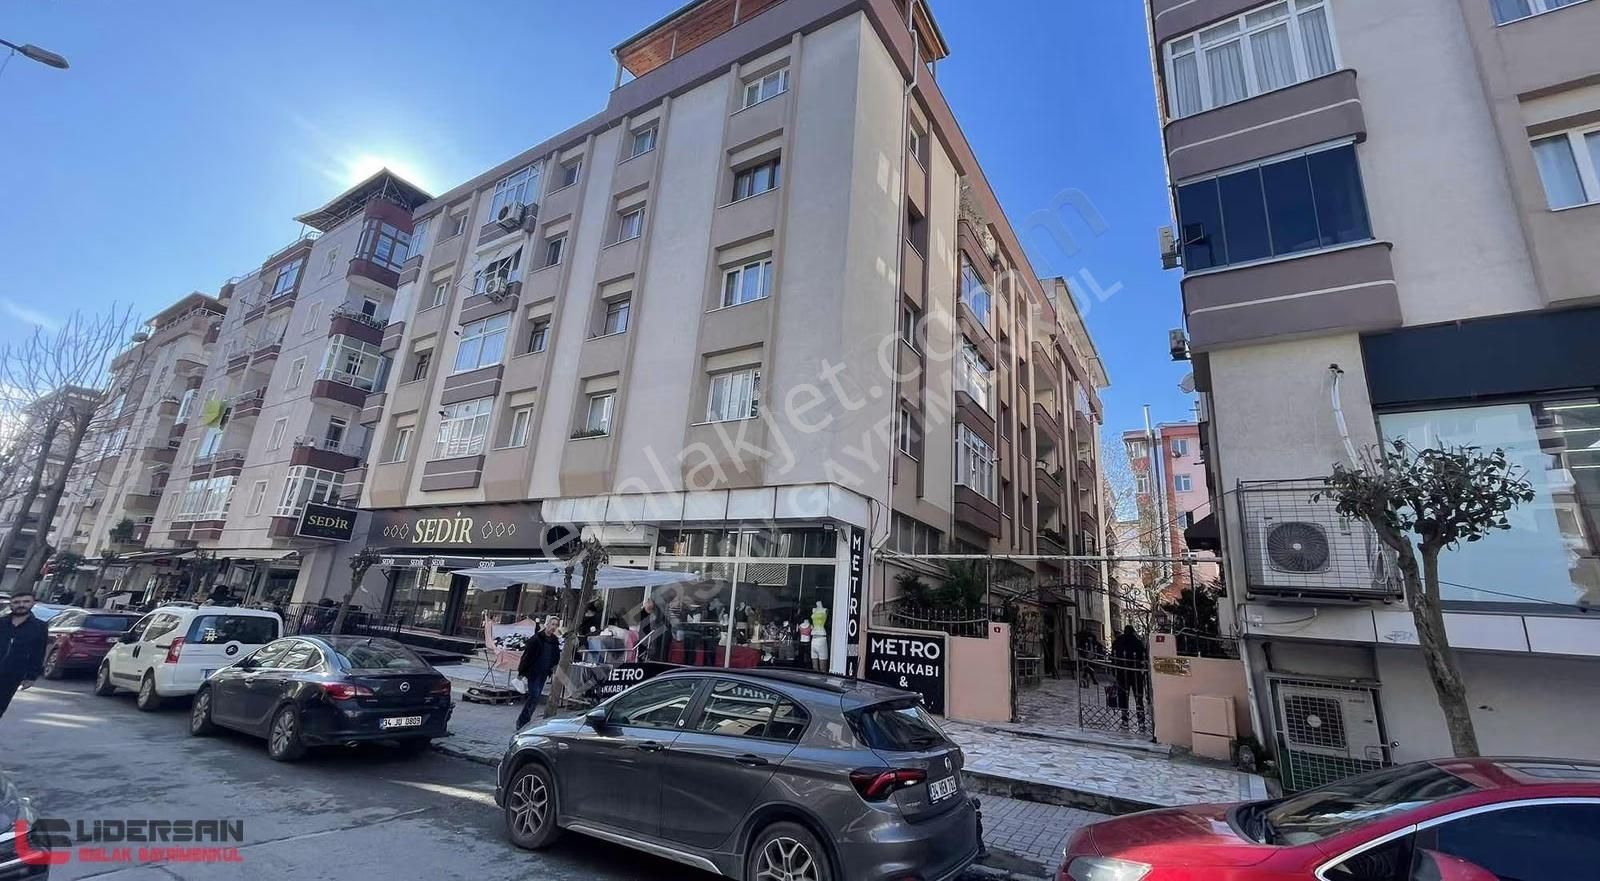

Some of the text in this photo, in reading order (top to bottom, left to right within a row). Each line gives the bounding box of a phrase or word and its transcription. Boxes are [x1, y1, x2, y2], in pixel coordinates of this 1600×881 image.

[308, 515, 348, 530] SEDİR
[412, 511, 473, 543] SEDİR
[848, 535, 861, 638] METRO
[871, 637, 940, 660] METRO
[872, 659, 939, 678] AYAKKABI
[899, 676, 909, 688] &
